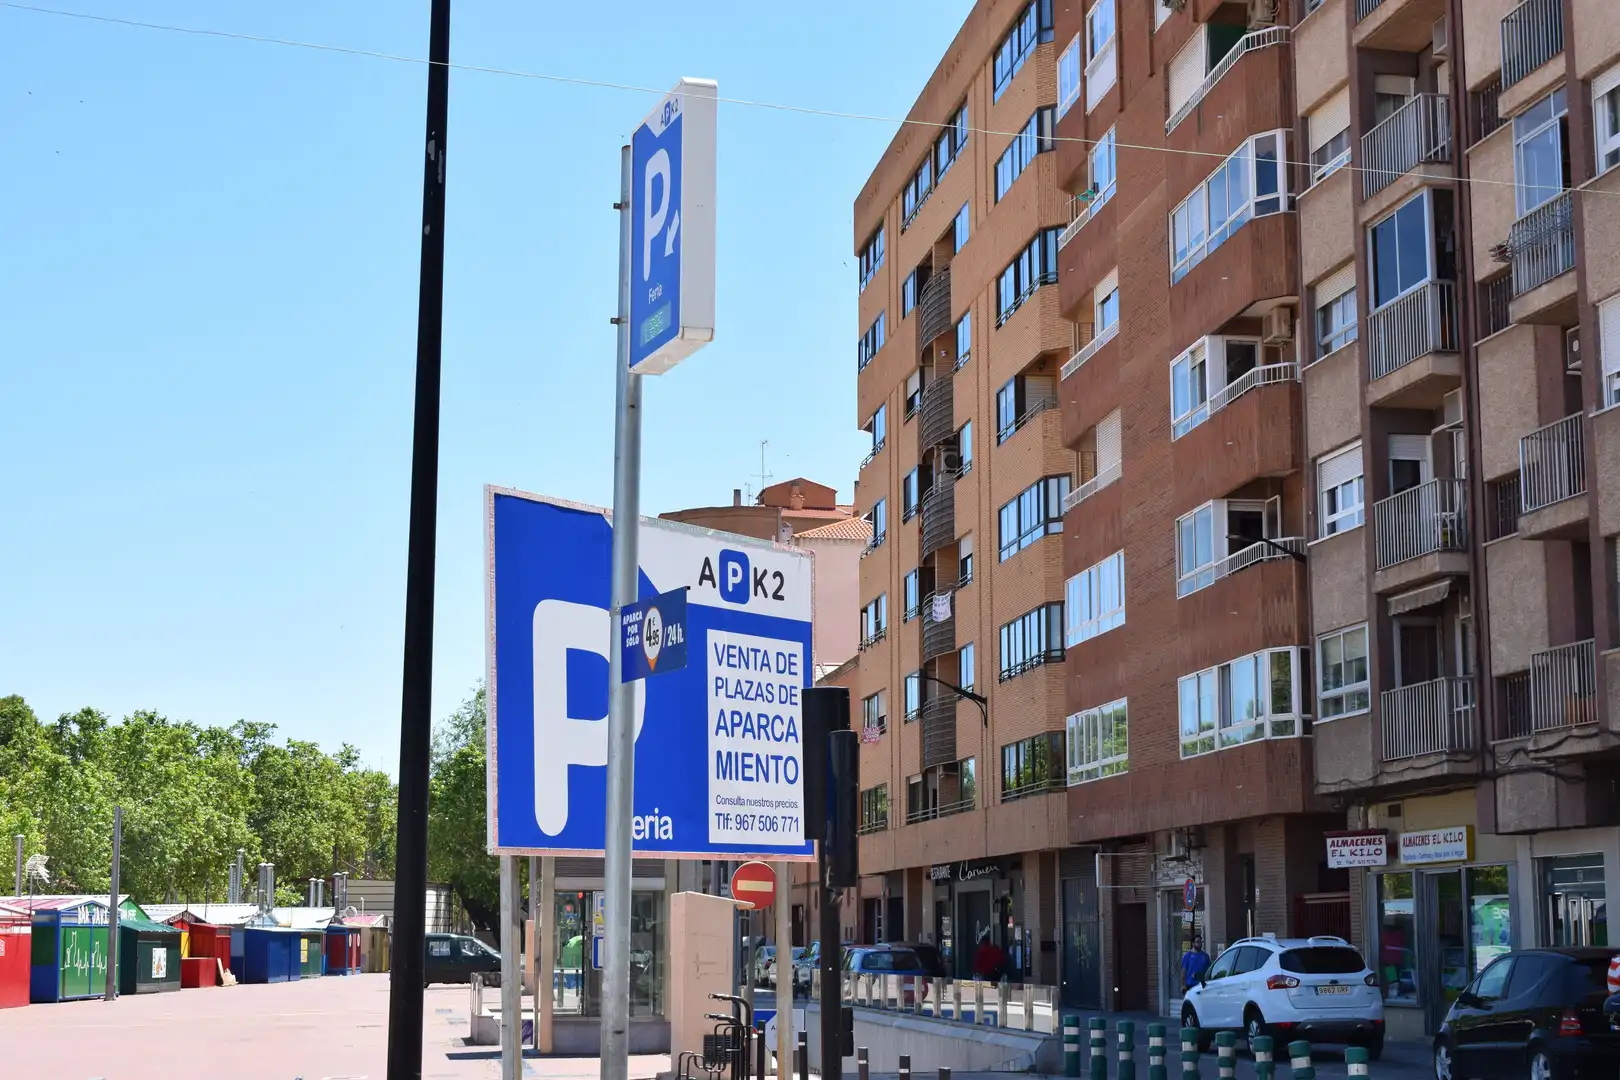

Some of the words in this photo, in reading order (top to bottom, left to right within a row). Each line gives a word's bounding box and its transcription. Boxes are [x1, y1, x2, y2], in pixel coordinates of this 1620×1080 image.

[644, 148, 670, 281] P
[648, 282, 663, 304] Feria
[623, 610, 643, 626] APARCA
[627, 623, 638, 636] POR
[714, 642, 771, 673] VENTA
[776, 651, 798, 676] DE
[715, 676, 775, 704] PLAZAS
[778, 684, 798, 706] DE
[533, 599, 646, 836] P
[715, 708, 799, 744] APARCA
[716, 749, 799, 785] MIENTO
[716, 794, 746, 807] Consulta
[746, 798, 774, 808] nuestros
[632, 807, 673, 840] eria
[714, 812, 733, 831] Tlf:
[735, 813, 756, 833] 967
[758, 815, 779, 833] 506
[781, 816, 799, 833] 771
[1330, 837, 1383, 848] ALMACENES
[1402, 835, 1430, 848] ALMACENES
[1432, 834, 1441, 845] EL
[1443, 831, 1464, 844] KILO
[1331, 849, 1345, 857] EL
[1349, 847, 1383, 857] KILO
[959, 860, 1000, 882] Carmen
